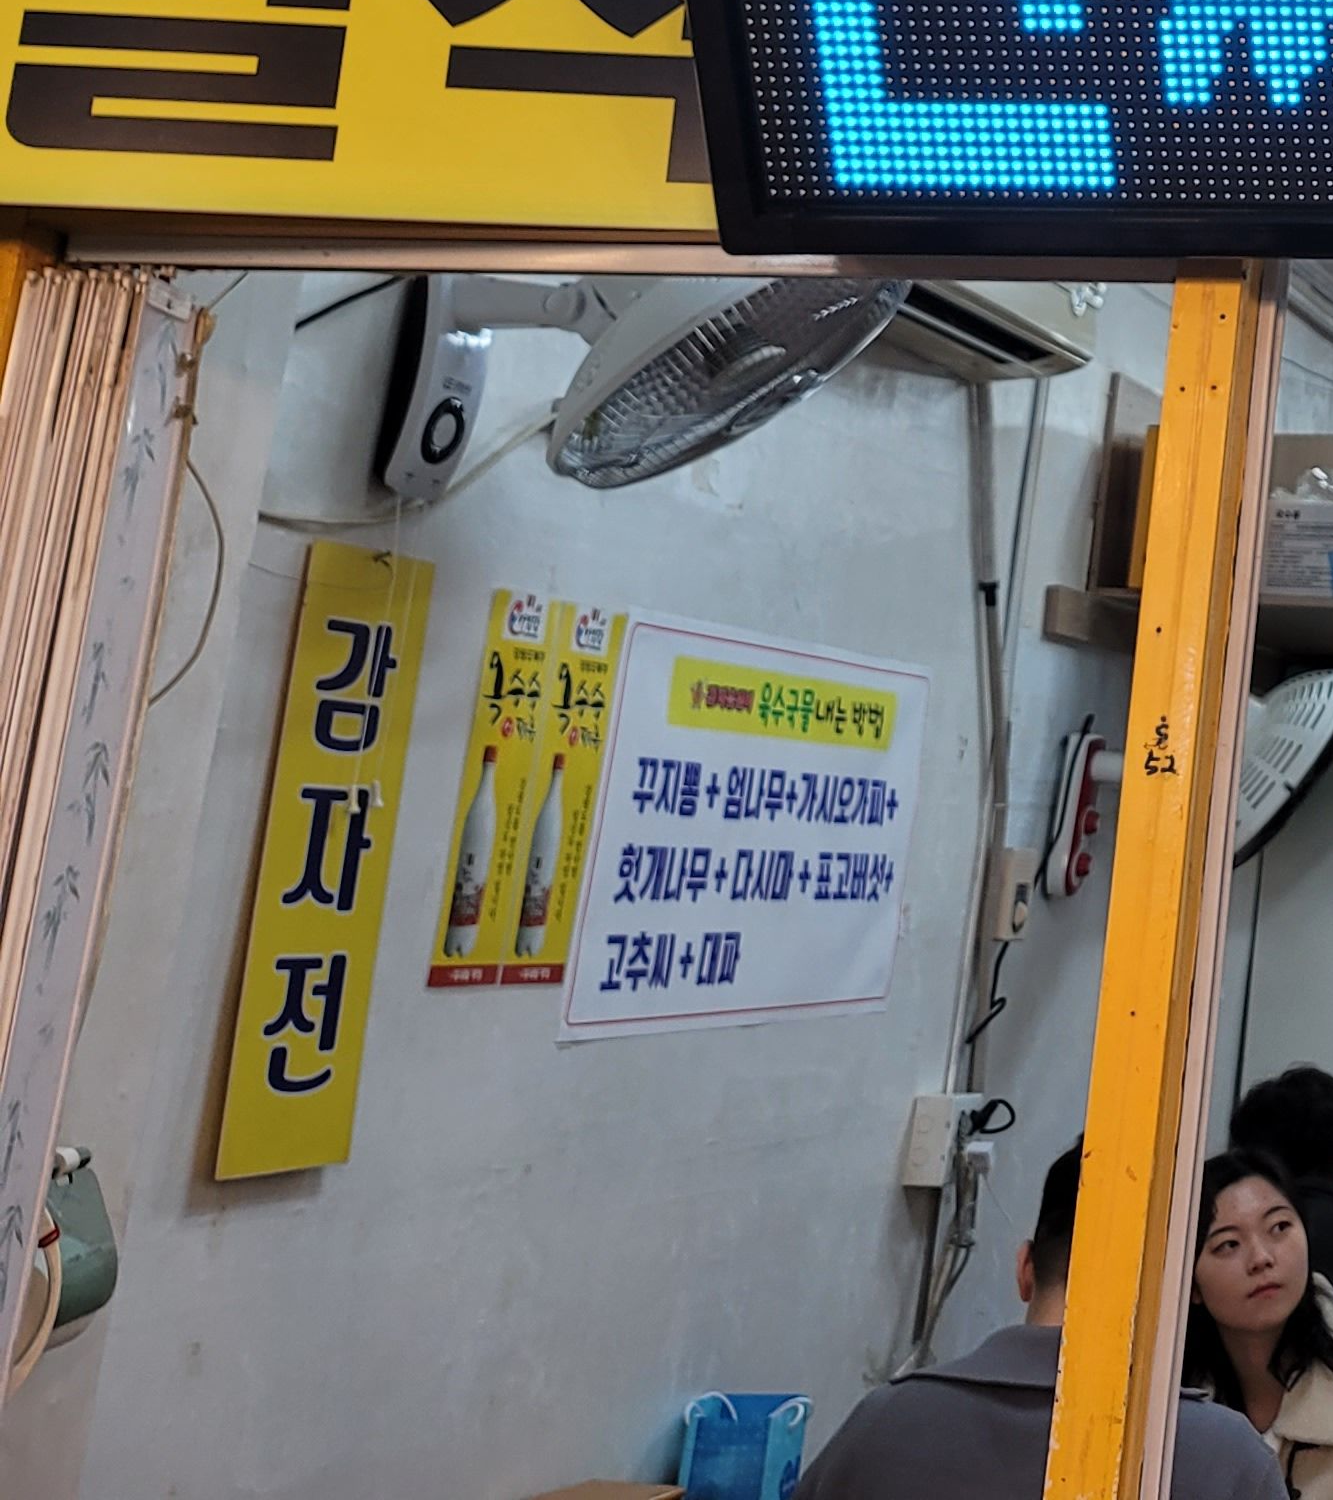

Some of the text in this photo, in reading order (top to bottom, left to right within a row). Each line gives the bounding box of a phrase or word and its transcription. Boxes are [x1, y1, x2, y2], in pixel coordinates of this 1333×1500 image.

[263, 617, 397, 1093] 감자전
[731, 849, 794, 901] 다시마
[599, 931, 676, 991] 고추씨
[696, 932, 741, 986] 대파
